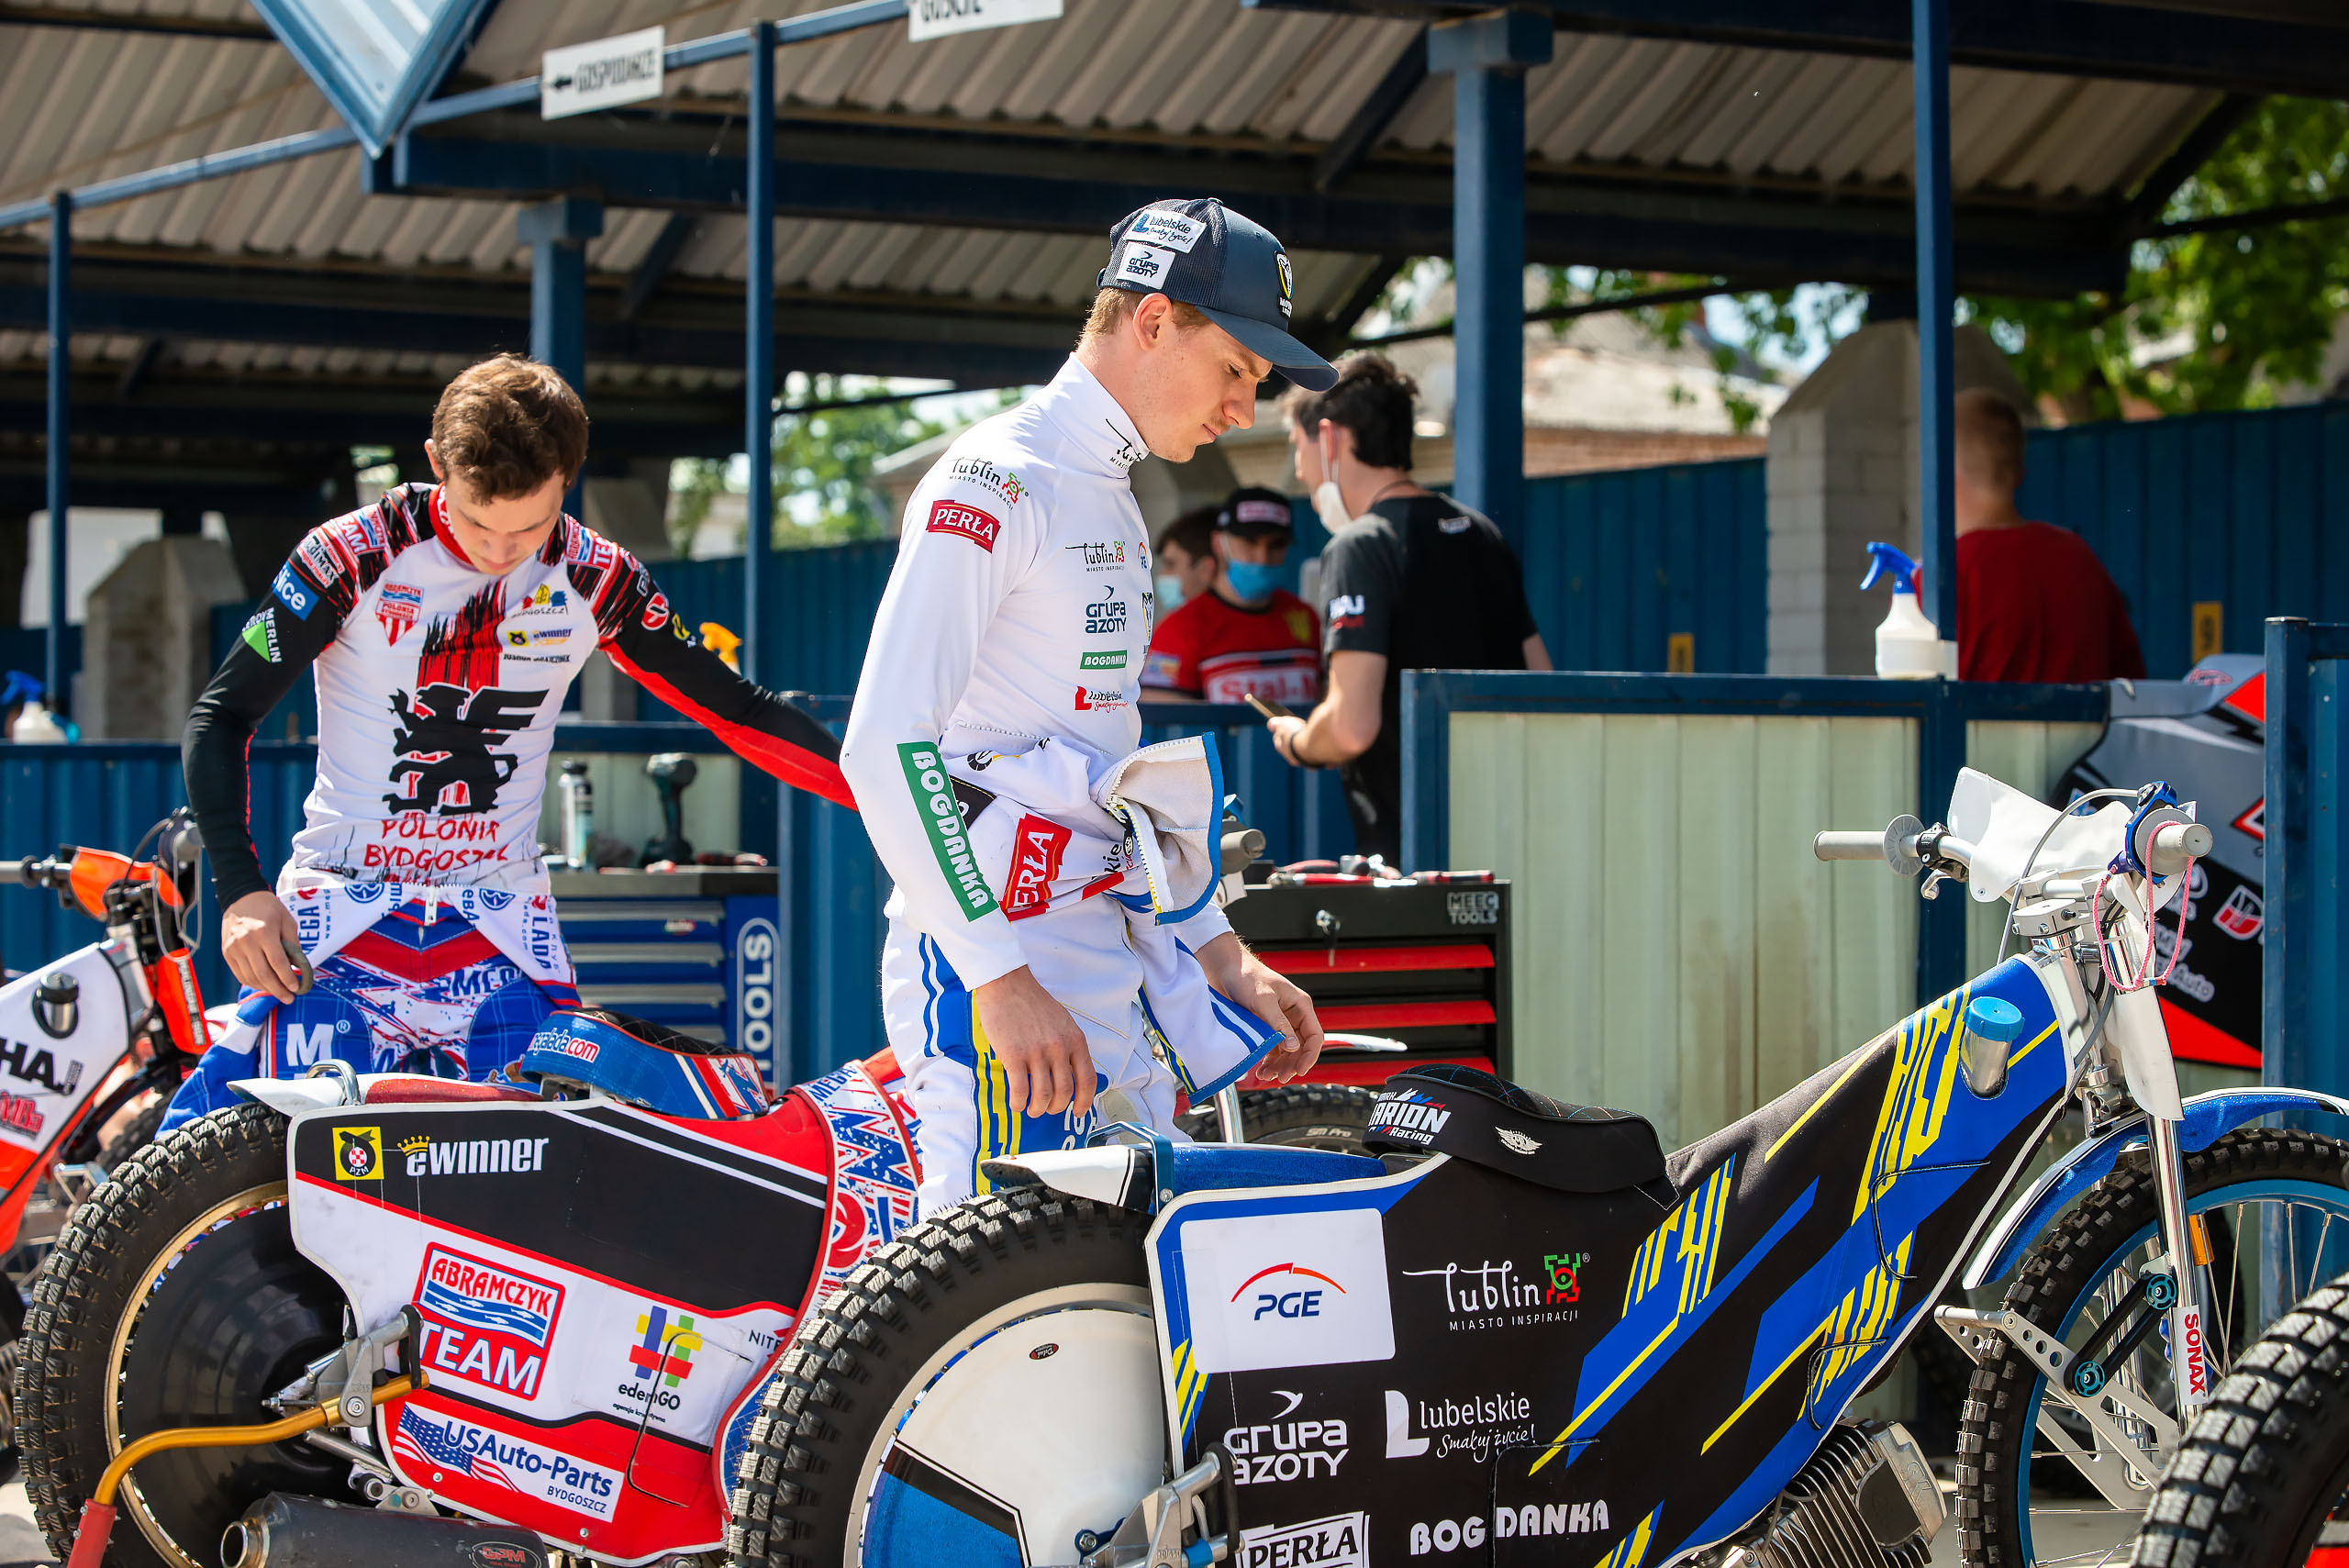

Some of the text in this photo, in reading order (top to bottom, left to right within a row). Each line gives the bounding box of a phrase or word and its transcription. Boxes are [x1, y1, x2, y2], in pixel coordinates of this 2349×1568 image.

[933, 508, 994, 541] PERŁA
[266, 607, 282, 663] MERLIN
[1084, 655, 1127, 666] BOGDANKA
[381, 819, 500, 842] POLONIA
[911, 750, 989, 908] BOGDANKA
[1013, 831, 1055, 908] ERŁA
[1447, 892, 1499, 911] MEEC
[1449, 910, 1497, 925] TOOLS
[1329, 1128, 1352, 1138] Pro
[1389, 1127, 1435, 1145] Racing
[349, 1165, 370, 1176] PZM
[431, 1258, 553, 1318] ABRAMCZYK
[1253, 1290, 1322, 1321] PGE
[1450, 1310, 1578, 1332] MIASTO INSPIRACJI
[2184, 1313, 2208, 1396] SONAX
[442, 1420, 614, 1497] USAuto-Parts
[1436, 1431, 1490, 1463] Smakuj
[547, 1485, 607, 1514] BYDGOSZCZ
[483, 1547, 526, 1563] GPM
[1249, 1525, 1360, 1568] PERŁA
